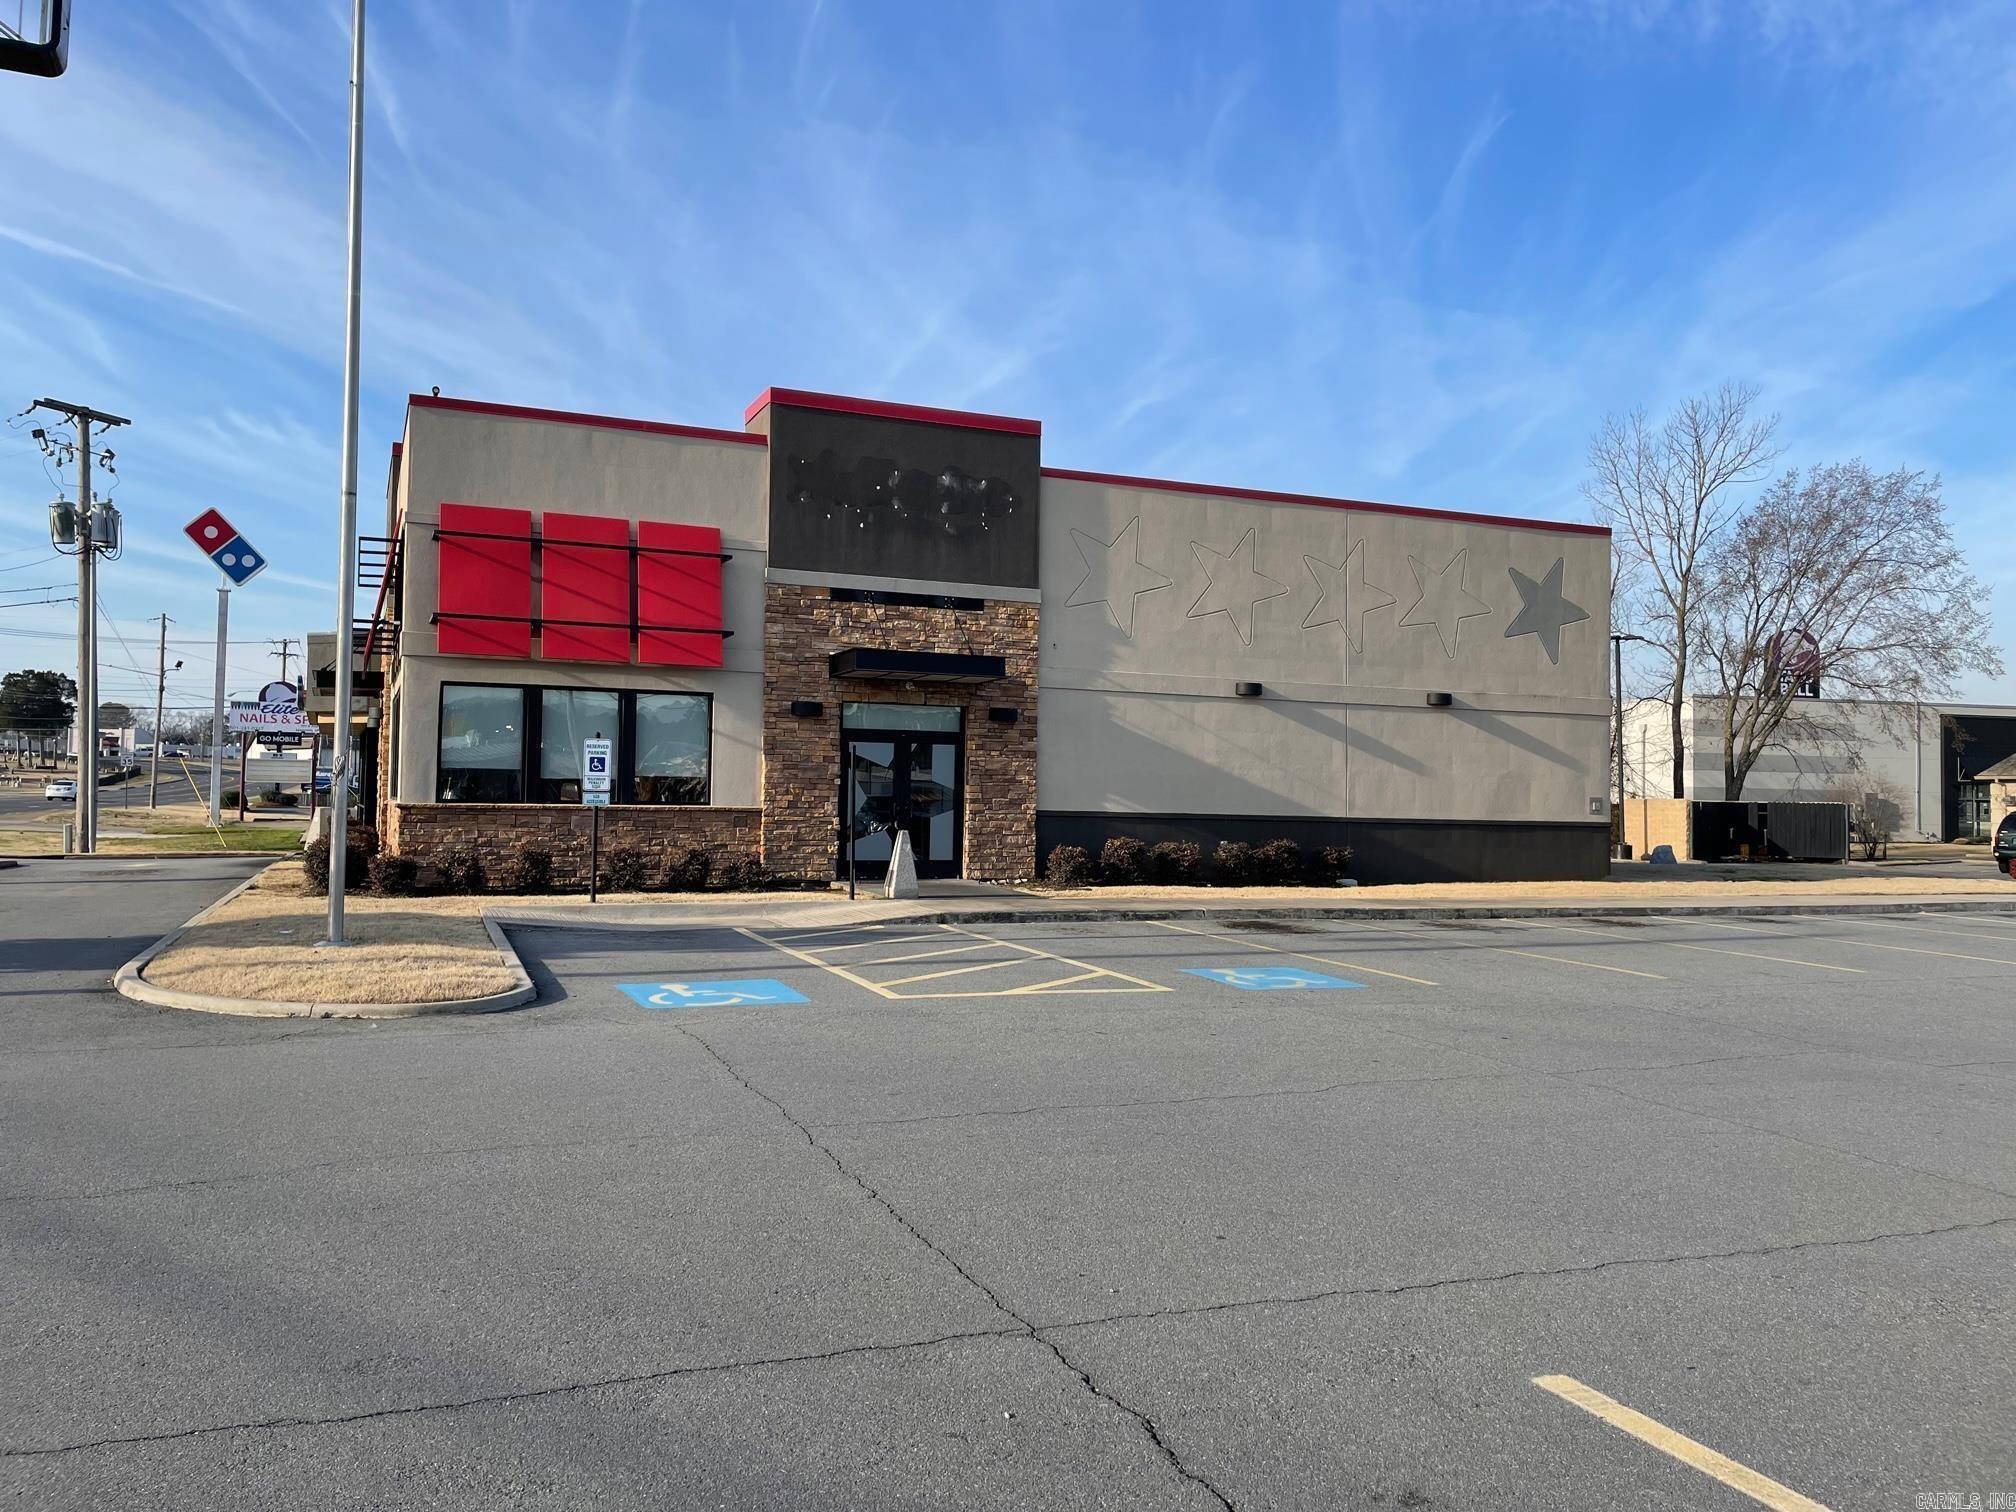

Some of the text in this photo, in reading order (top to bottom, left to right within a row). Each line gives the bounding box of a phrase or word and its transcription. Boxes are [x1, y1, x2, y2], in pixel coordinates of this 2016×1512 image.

[260, 704, 299, 714] Elite
[239, 713, 310, 724] NAILS & SP
[272, 735, 299, 743] MOBILE
